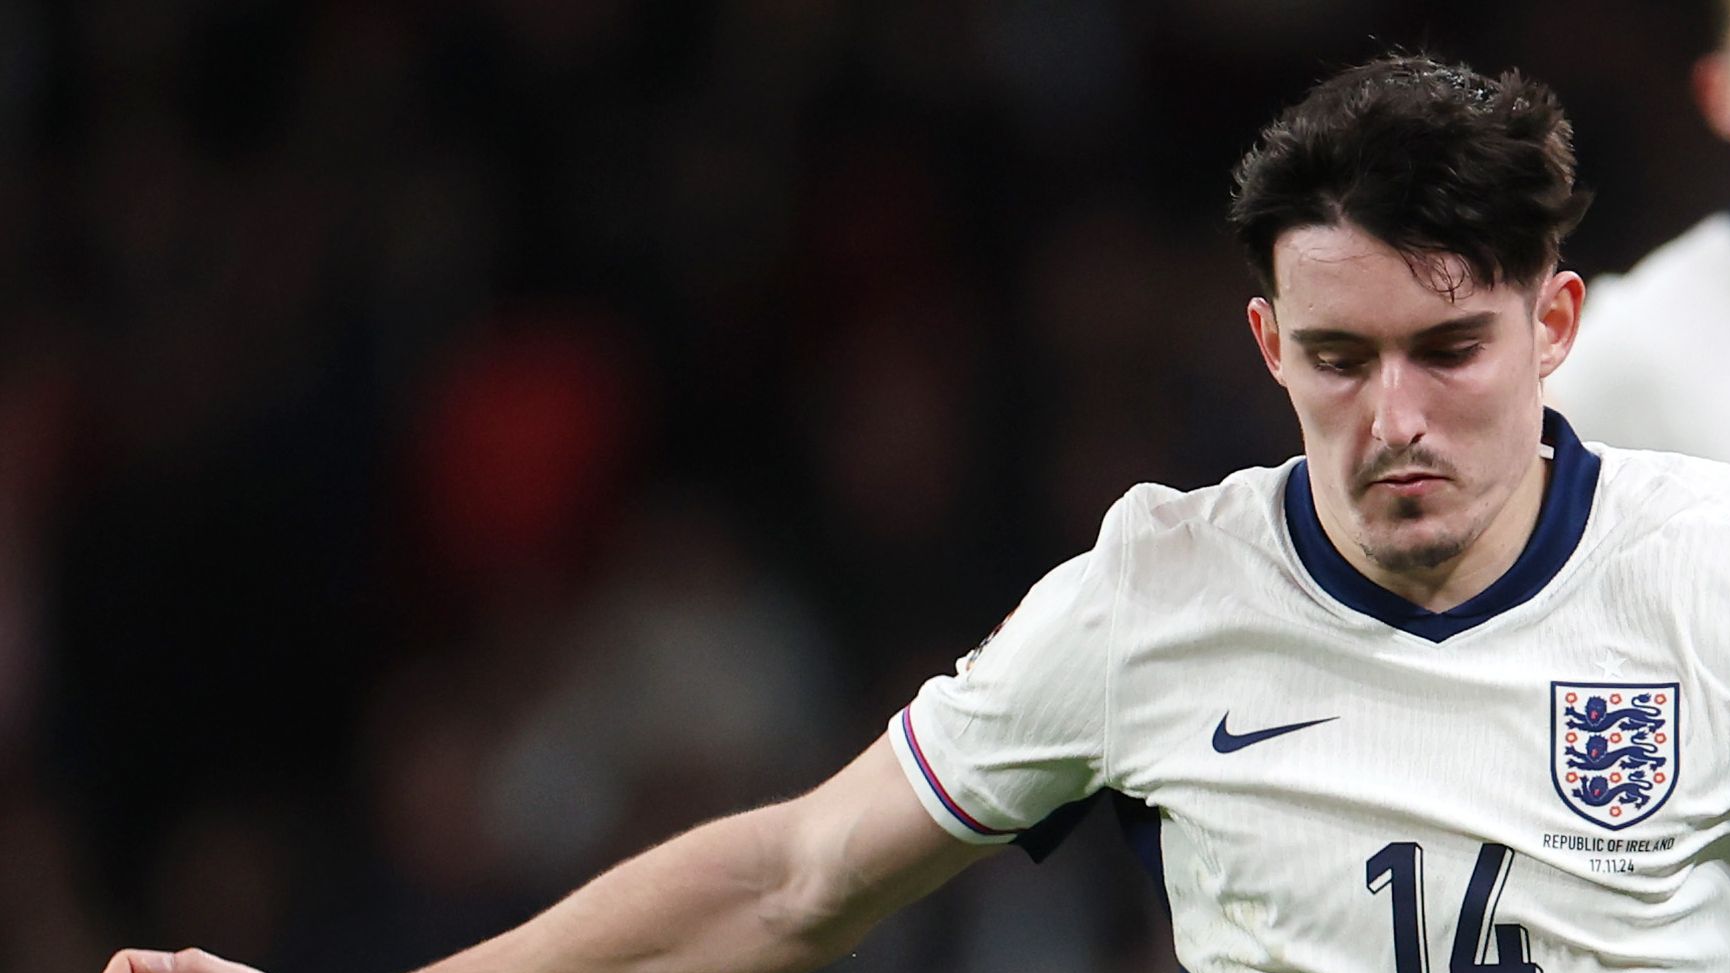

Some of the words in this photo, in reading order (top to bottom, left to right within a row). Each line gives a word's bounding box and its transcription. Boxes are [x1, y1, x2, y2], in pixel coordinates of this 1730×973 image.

[1543, 834, 1604, 852] REPUBLIC
[1607, 839, 1623, 852] OF
[1626, 837, 1676, 853] IRELAND
[1590, 859, 1634, 873] 17.11.24
